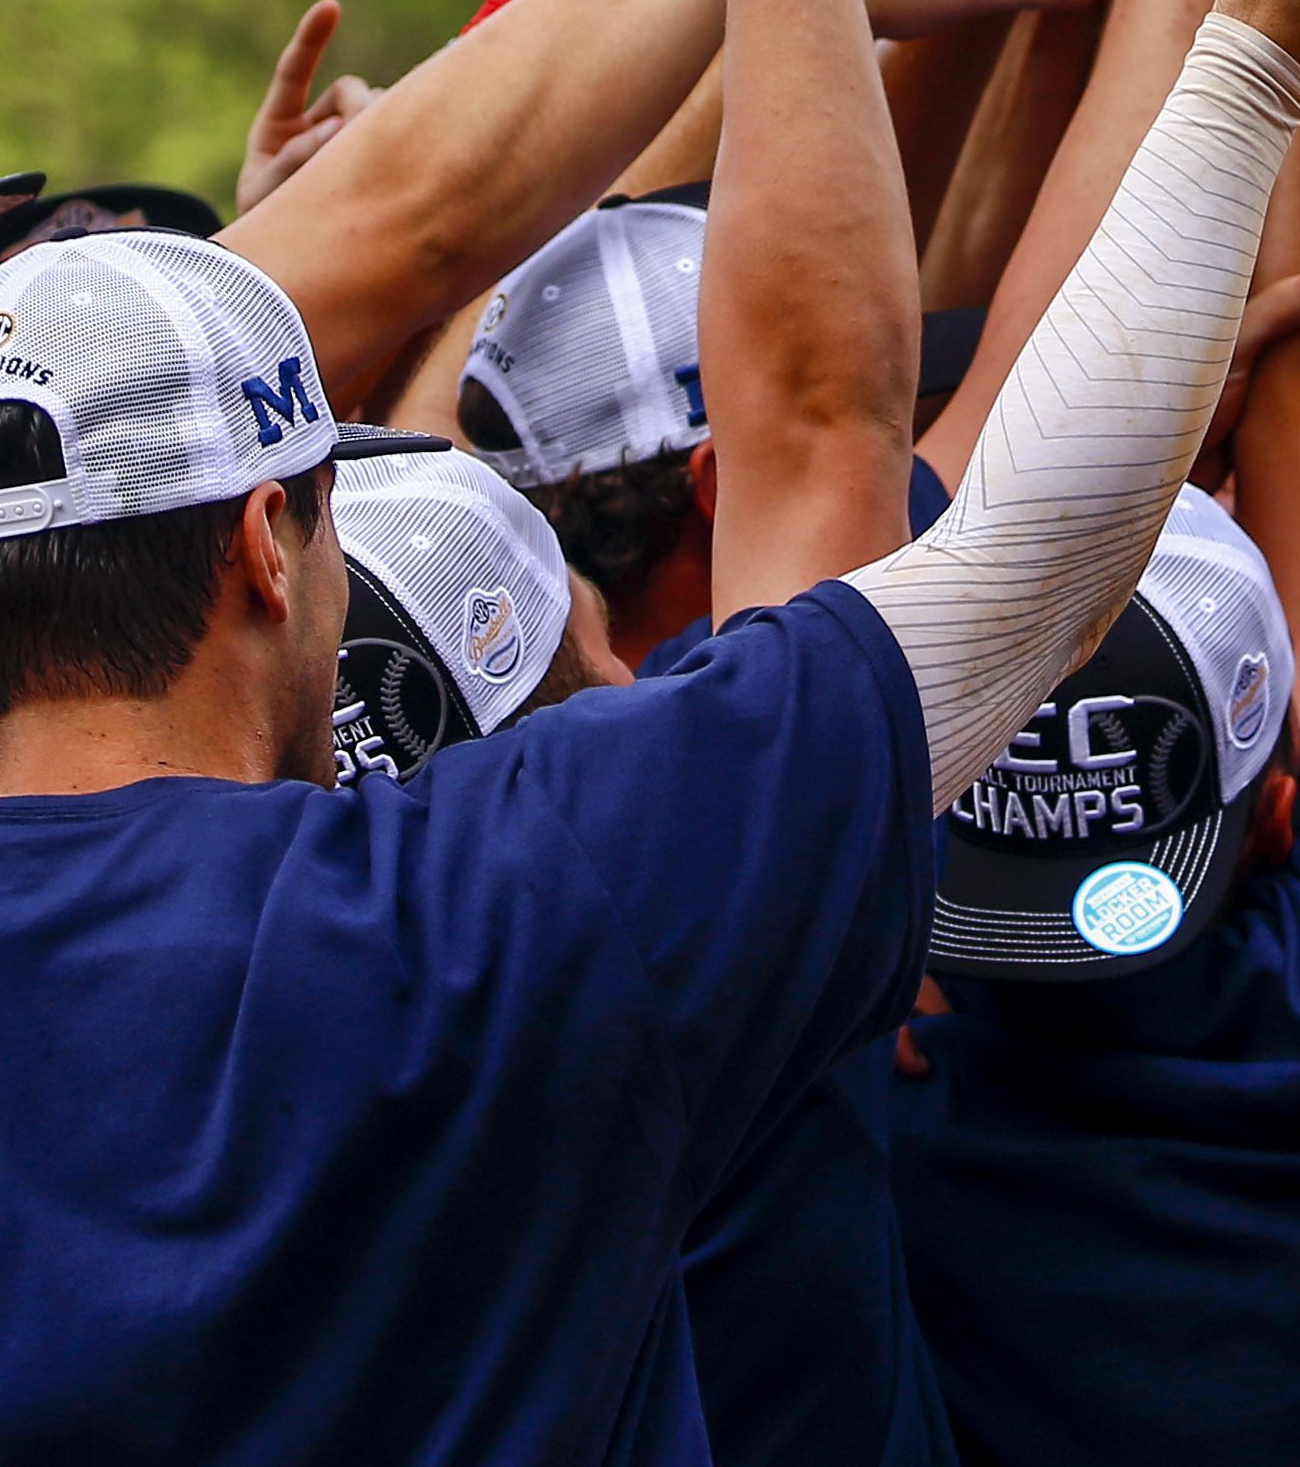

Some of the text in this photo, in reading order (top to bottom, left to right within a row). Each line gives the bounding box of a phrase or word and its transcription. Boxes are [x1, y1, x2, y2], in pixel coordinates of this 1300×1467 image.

[241, 357, 319, 447] M
[993, 695, 1137, 772] EC
[1014, 766, 1138, 793] TOURNAMENT
[1085, 875, 1154, 929] LOCKER
[1100, 889, 1169, 941] ROOM
